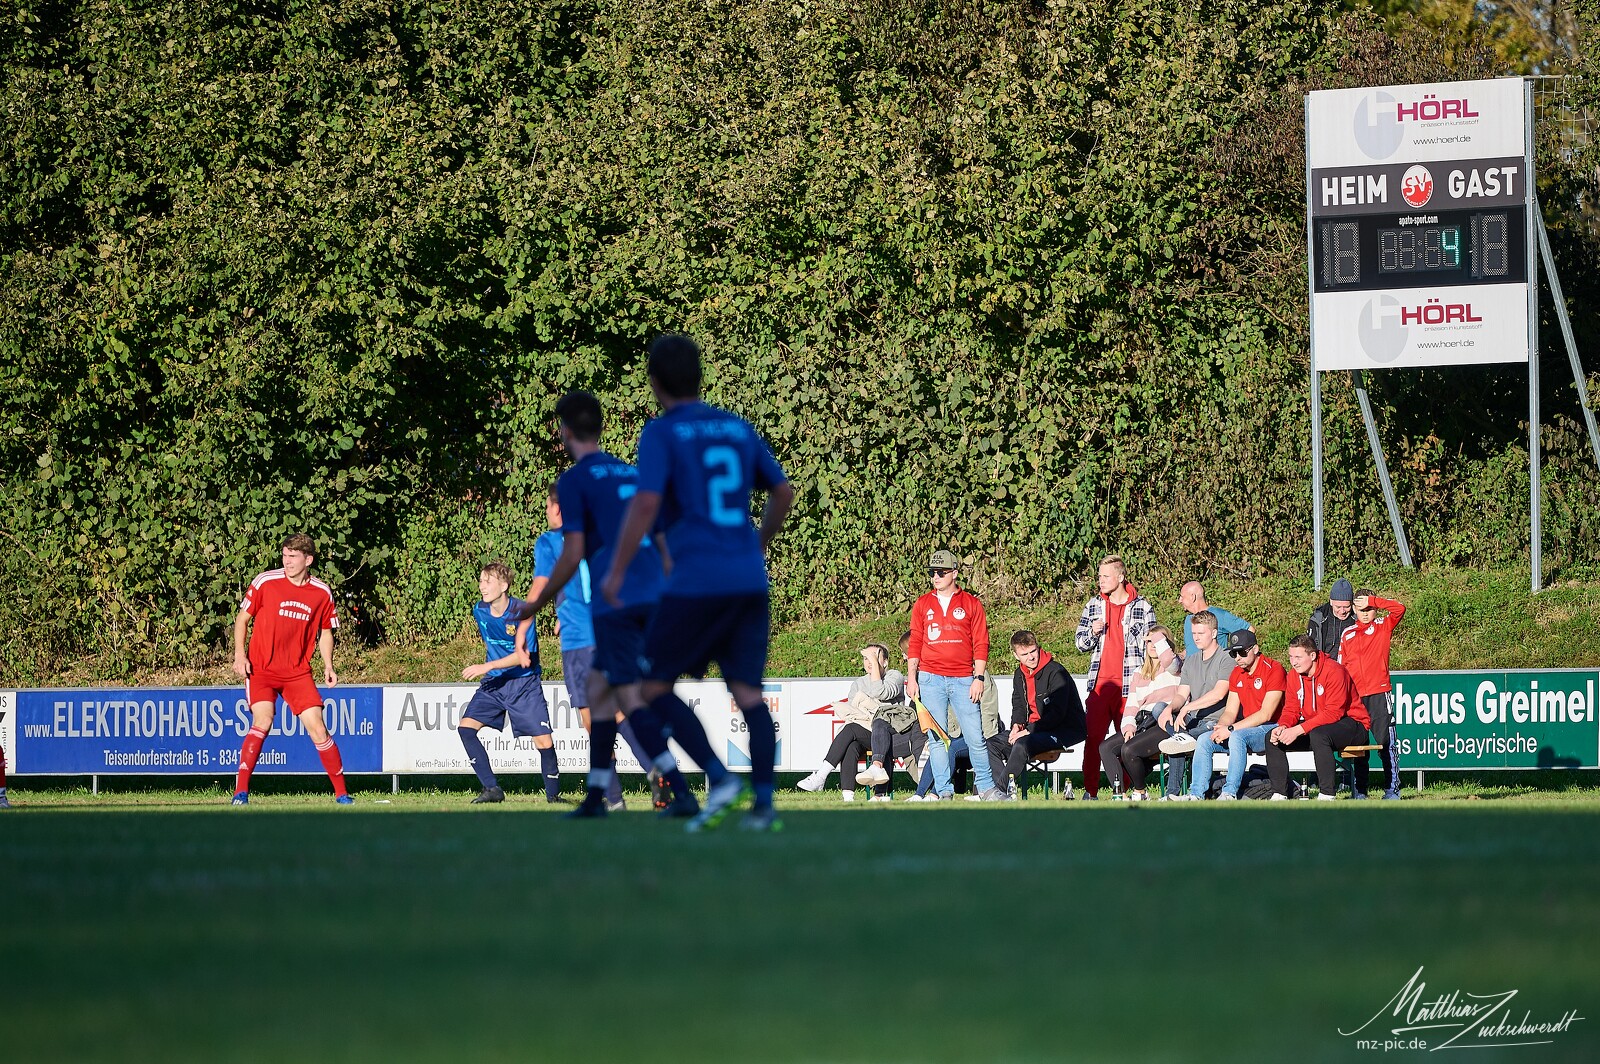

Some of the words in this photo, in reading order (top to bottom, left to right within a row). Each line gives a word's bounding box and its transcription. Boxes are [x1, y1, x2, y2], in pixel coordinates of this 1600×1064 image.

[1397, 94, 1479, 122] HÖRL
[1413, 135, 1471, 145] www.hoerl.de
[1322, 174, 1387, 206] HEIM
[1448, 167, 1517, 198] GAST
[1401, 298, 1482, 325] HÖRL
[1417, 340, 1474, 348] www.hoerl.de
[702, 445, 747, 527] 2
[278, 609, 310, 621] GREIMEL
[279, 600, 312, 614] GASTHAUS
[1475, 679, 1594, 724] Greimel
[494, 737, 511, 751] Ihr
[513, 737, 535, 751] Aut
[569, 736, 591, 751] wir
[1416, 732, 1538, 760] urig-bayrische
[103, 749, 194, 766] Teisendorferstraße
[196, 749, 209, 766] 15
[256, 748, 287, 765] aufen
[415, 758, 462, 768] Kiem-Pauli-Str.
[500, 758, 523, 768] Laufen
[528, 758, 539, 768] Tel.
[578, 758, 587, 767] 33
